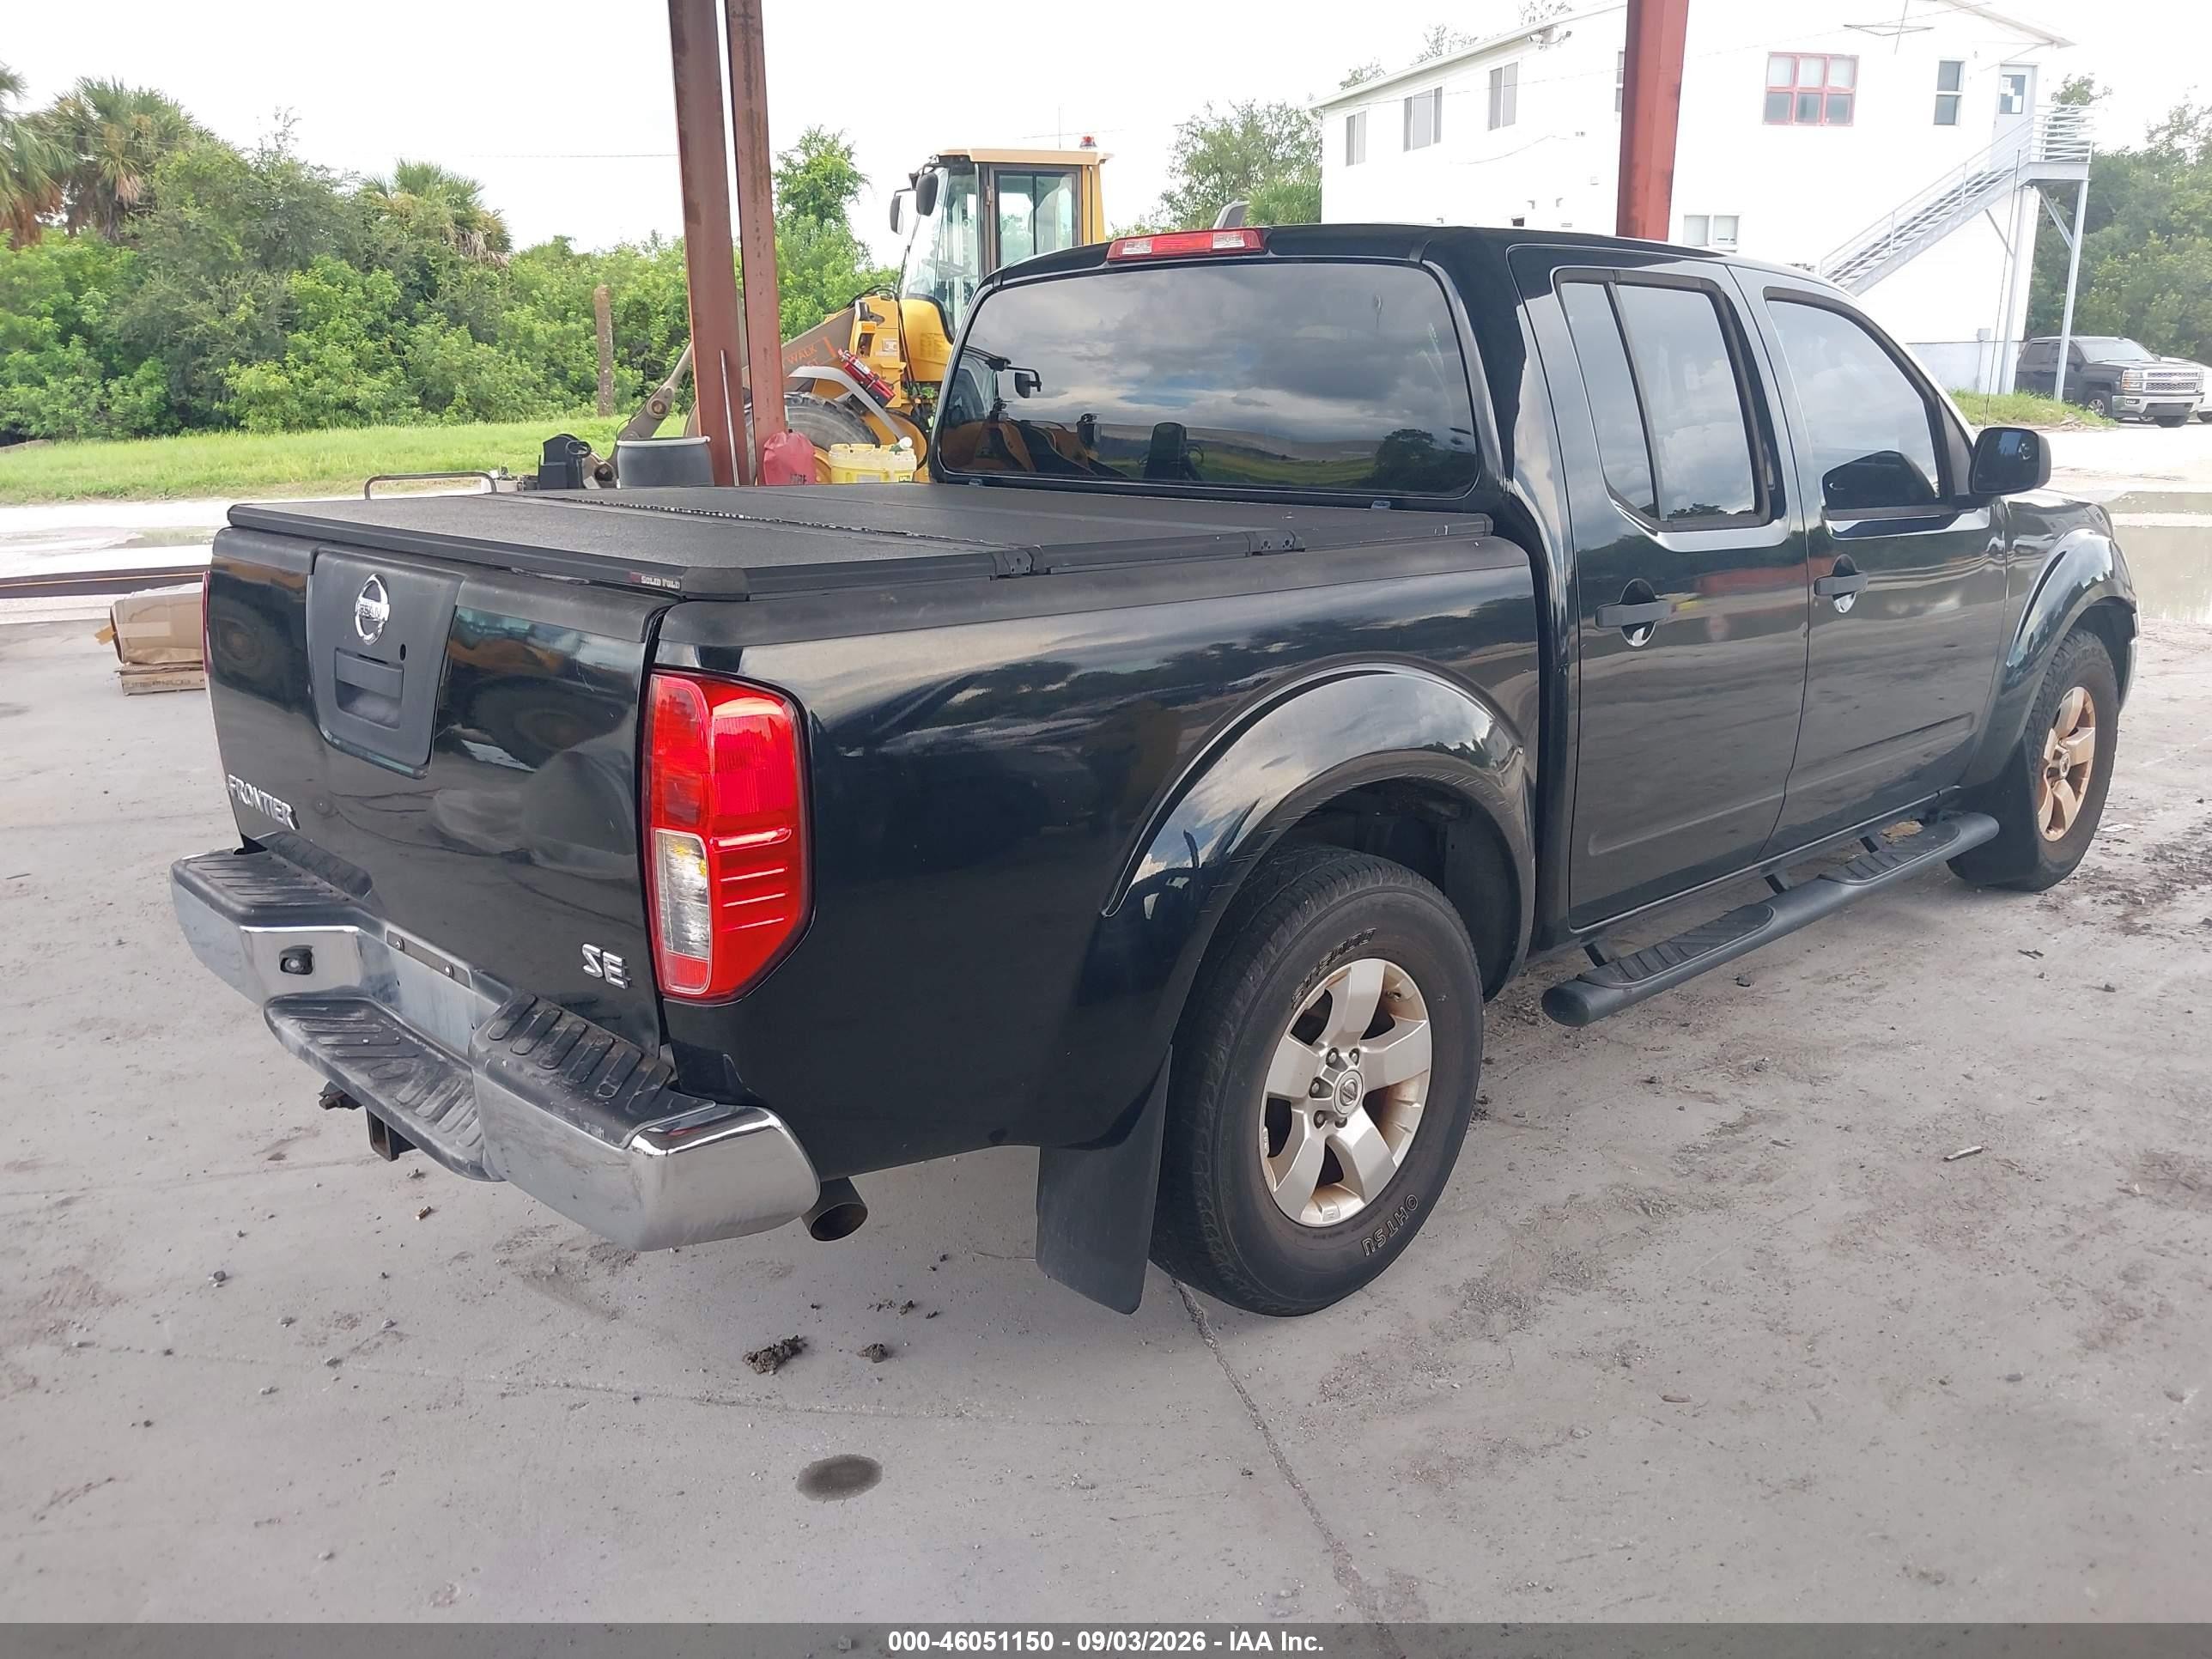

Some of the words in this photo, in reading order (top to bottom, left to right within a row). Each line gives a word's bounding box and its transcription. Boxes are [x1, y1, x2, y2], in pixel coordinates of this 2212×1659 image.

[641, 575, 661, 586] SOLID
[227, 774, 296, 831] FRONTIER
[581, 943, 629, 989] SE
[1361, 1194, 1419, 1256] OHTSU
